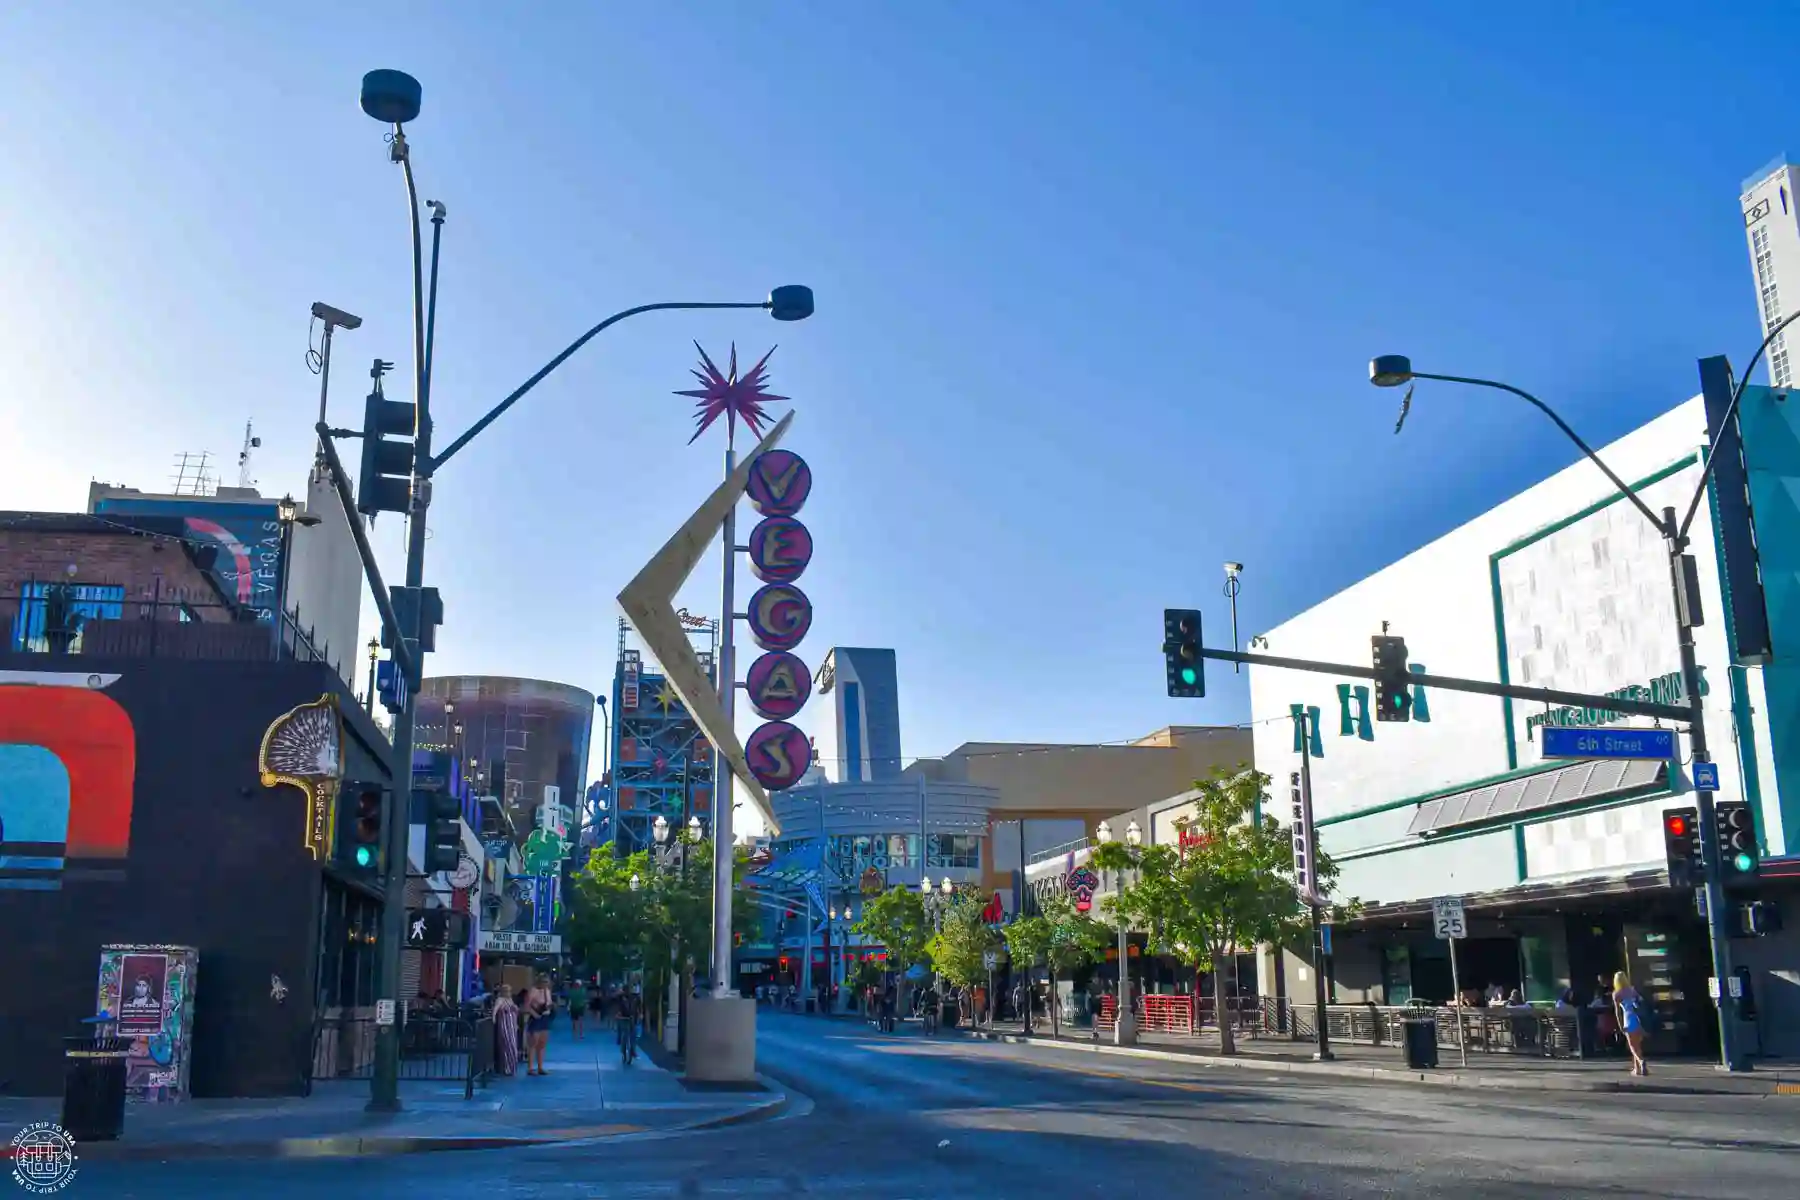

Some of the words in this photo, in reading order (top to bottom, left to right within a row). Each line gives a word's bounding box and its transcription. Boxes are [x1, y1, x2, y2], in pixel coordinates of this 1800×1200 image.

[753, 455, 806, 779] VEGAS
[1577, 738, 1599, 751] 6th
[1605, 738, 1643, 752] Street
[315, 783, 325, 841] COCKTAILS
[1290, 771, 1306, 886] FREMONT
[1438, 919, 1463, 934] 25
